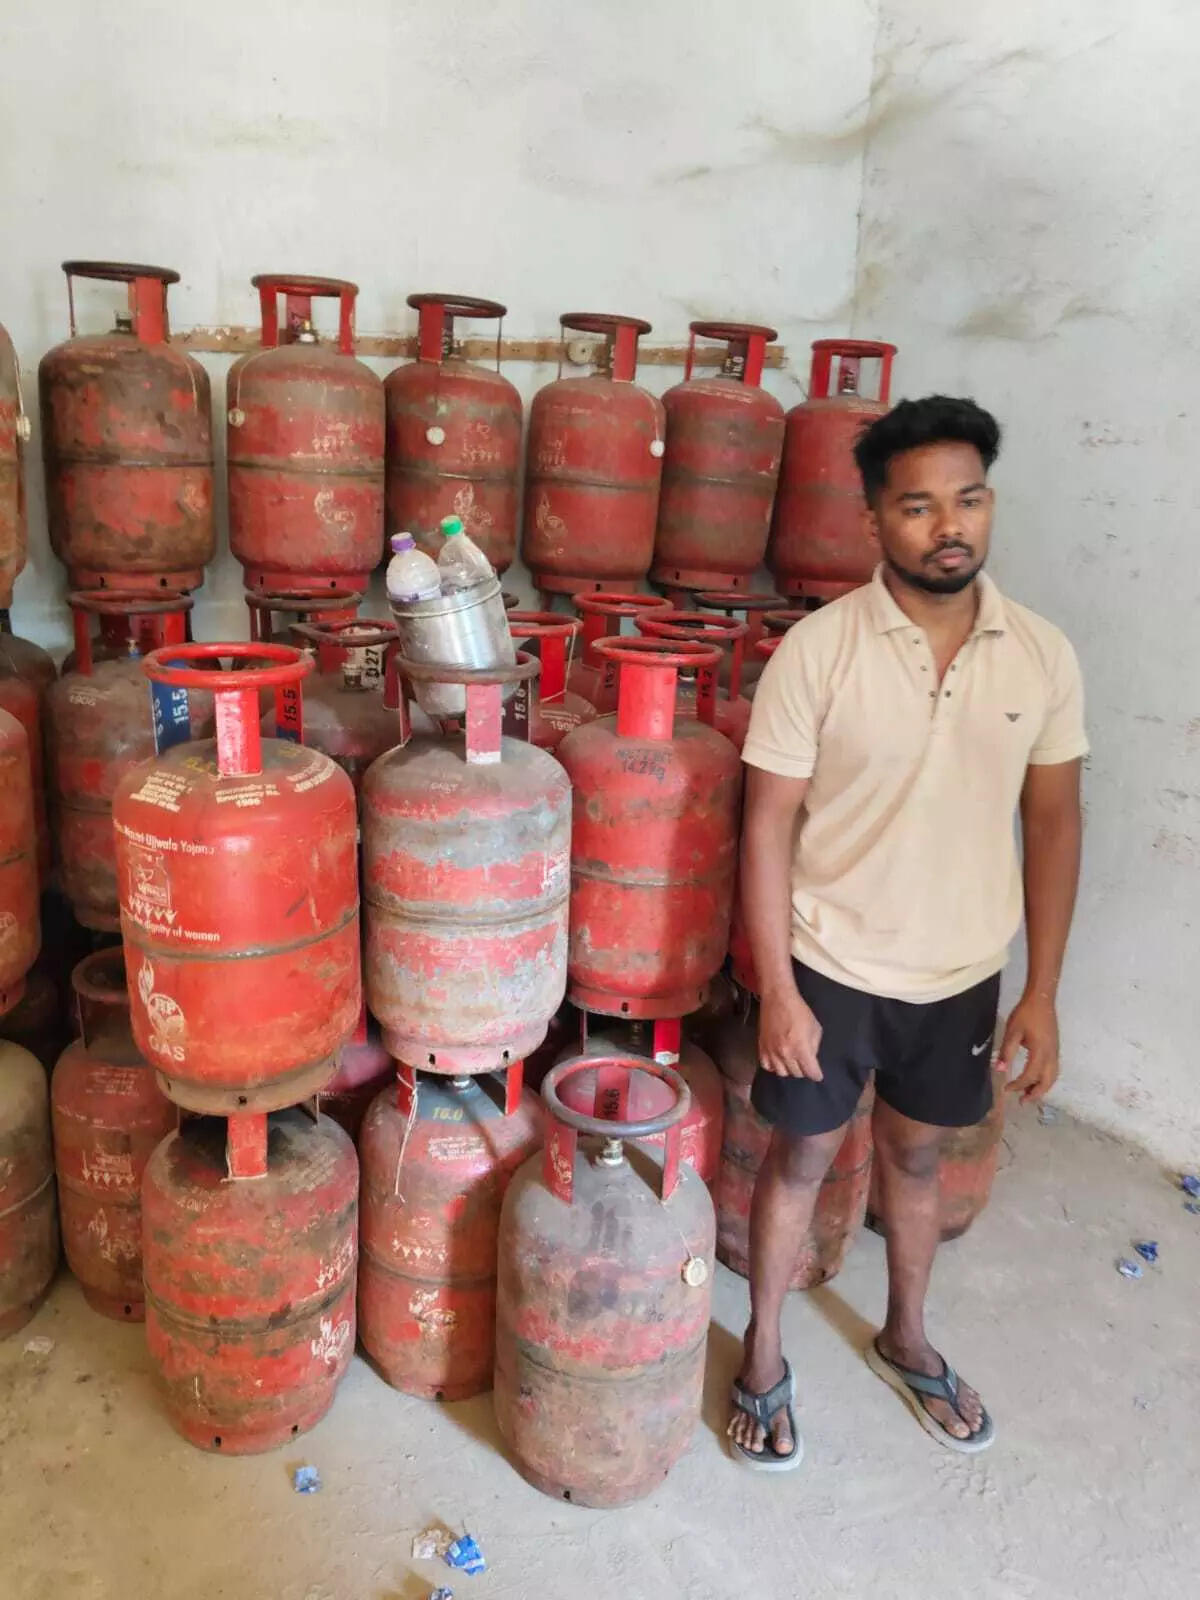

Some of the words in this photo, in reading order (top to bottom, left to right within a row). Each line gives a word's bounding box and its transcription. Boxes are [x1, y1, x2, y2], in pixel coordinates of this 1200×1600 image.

[172, 688, 189, 725] 15.5
[283, 688, 297, 722] 15.5
[184, 929, 220, 942] women
[148, 1034, 186, 1063] GAS
